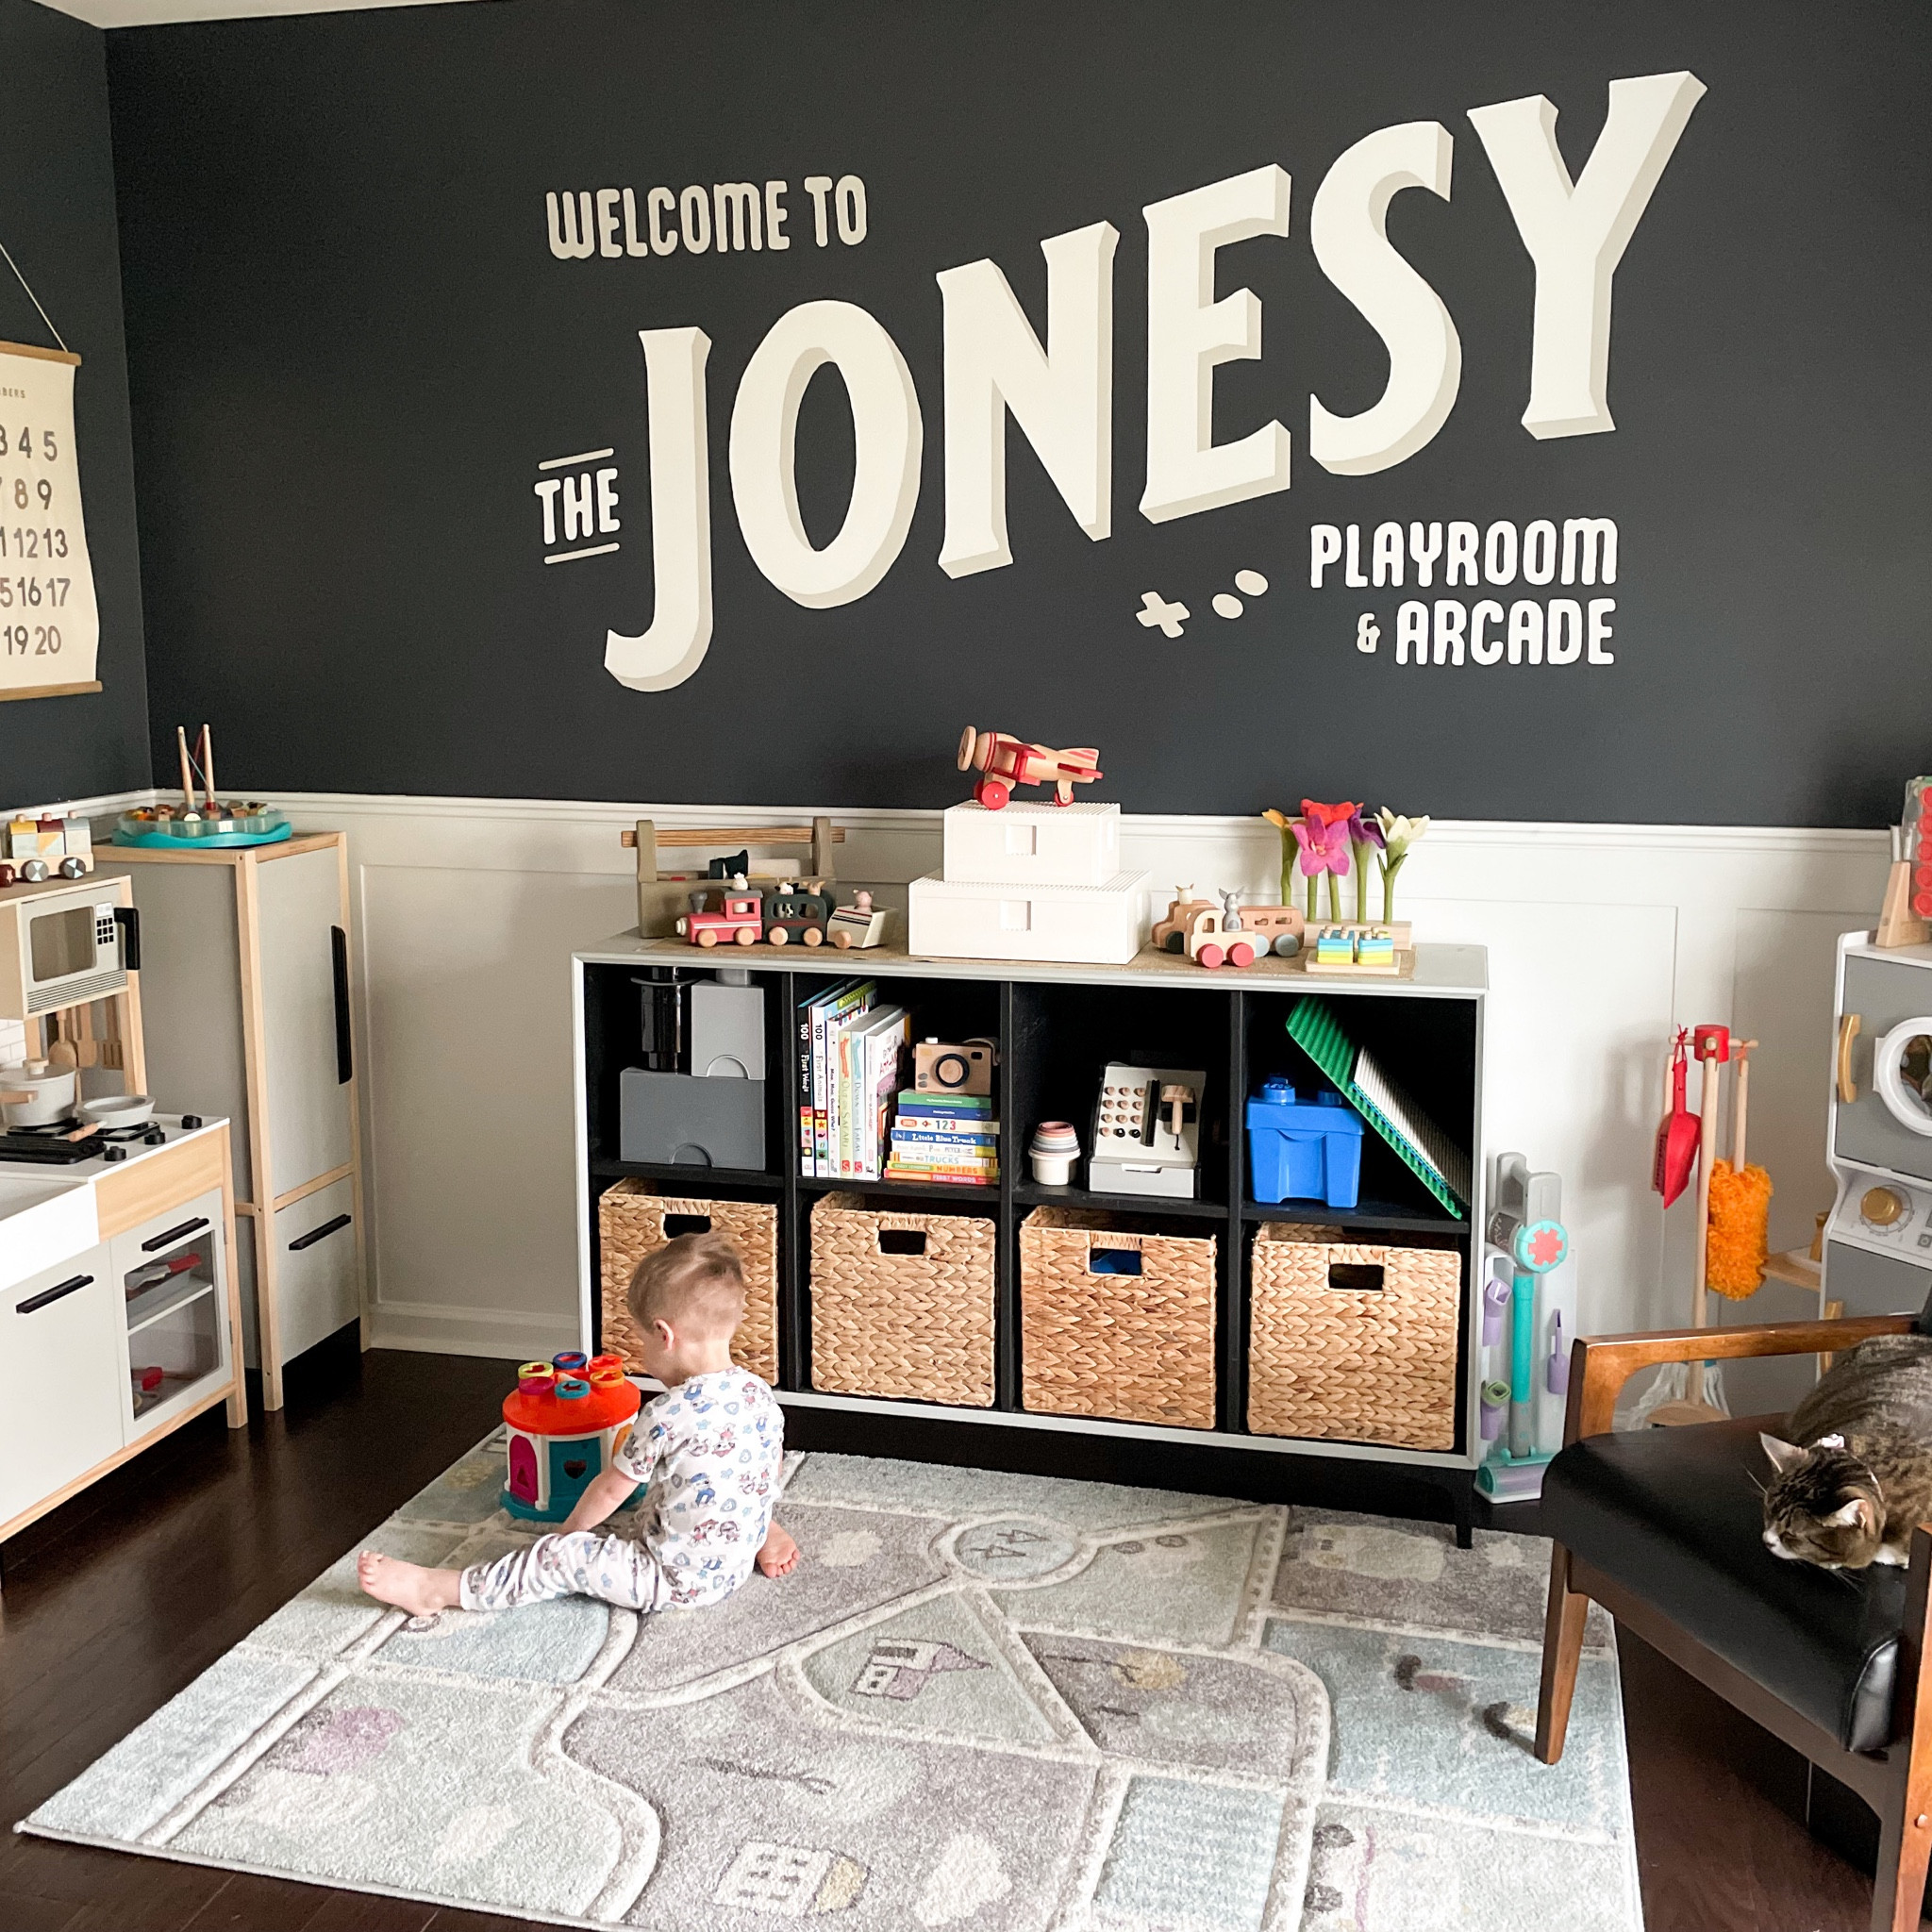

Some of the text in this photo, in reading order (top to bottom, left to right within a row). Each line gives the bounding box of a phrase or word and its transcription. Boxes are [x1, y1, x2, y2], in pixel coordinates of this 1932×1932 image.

[546, 175, 867, 258] WELCOME TO
[535, 71, 1707, 691] THE JONESY
[18, 426, 33, 458] 4
[43, 430, 58, 461] 5
[14, 478, 52, 510] 8 9
[13, 527, 39, 558] 12
[42, 528, 69, 558] 13
[1311, 518, 1618, 588] PLAYROOM
[17, 576, 42, 607] 16
[46, 577, 71, 607] 17
[4, 625, 61, 656] 19 20
[1357, 598, 1616, 665] & ARCADE
[800, 1023, 809, 1041] 100
[815, 1024, 824, 1041] 100
[924, 1155, 959, 1165] TRUCKS
[936, 1165, 978, 1174] NUMBERS
